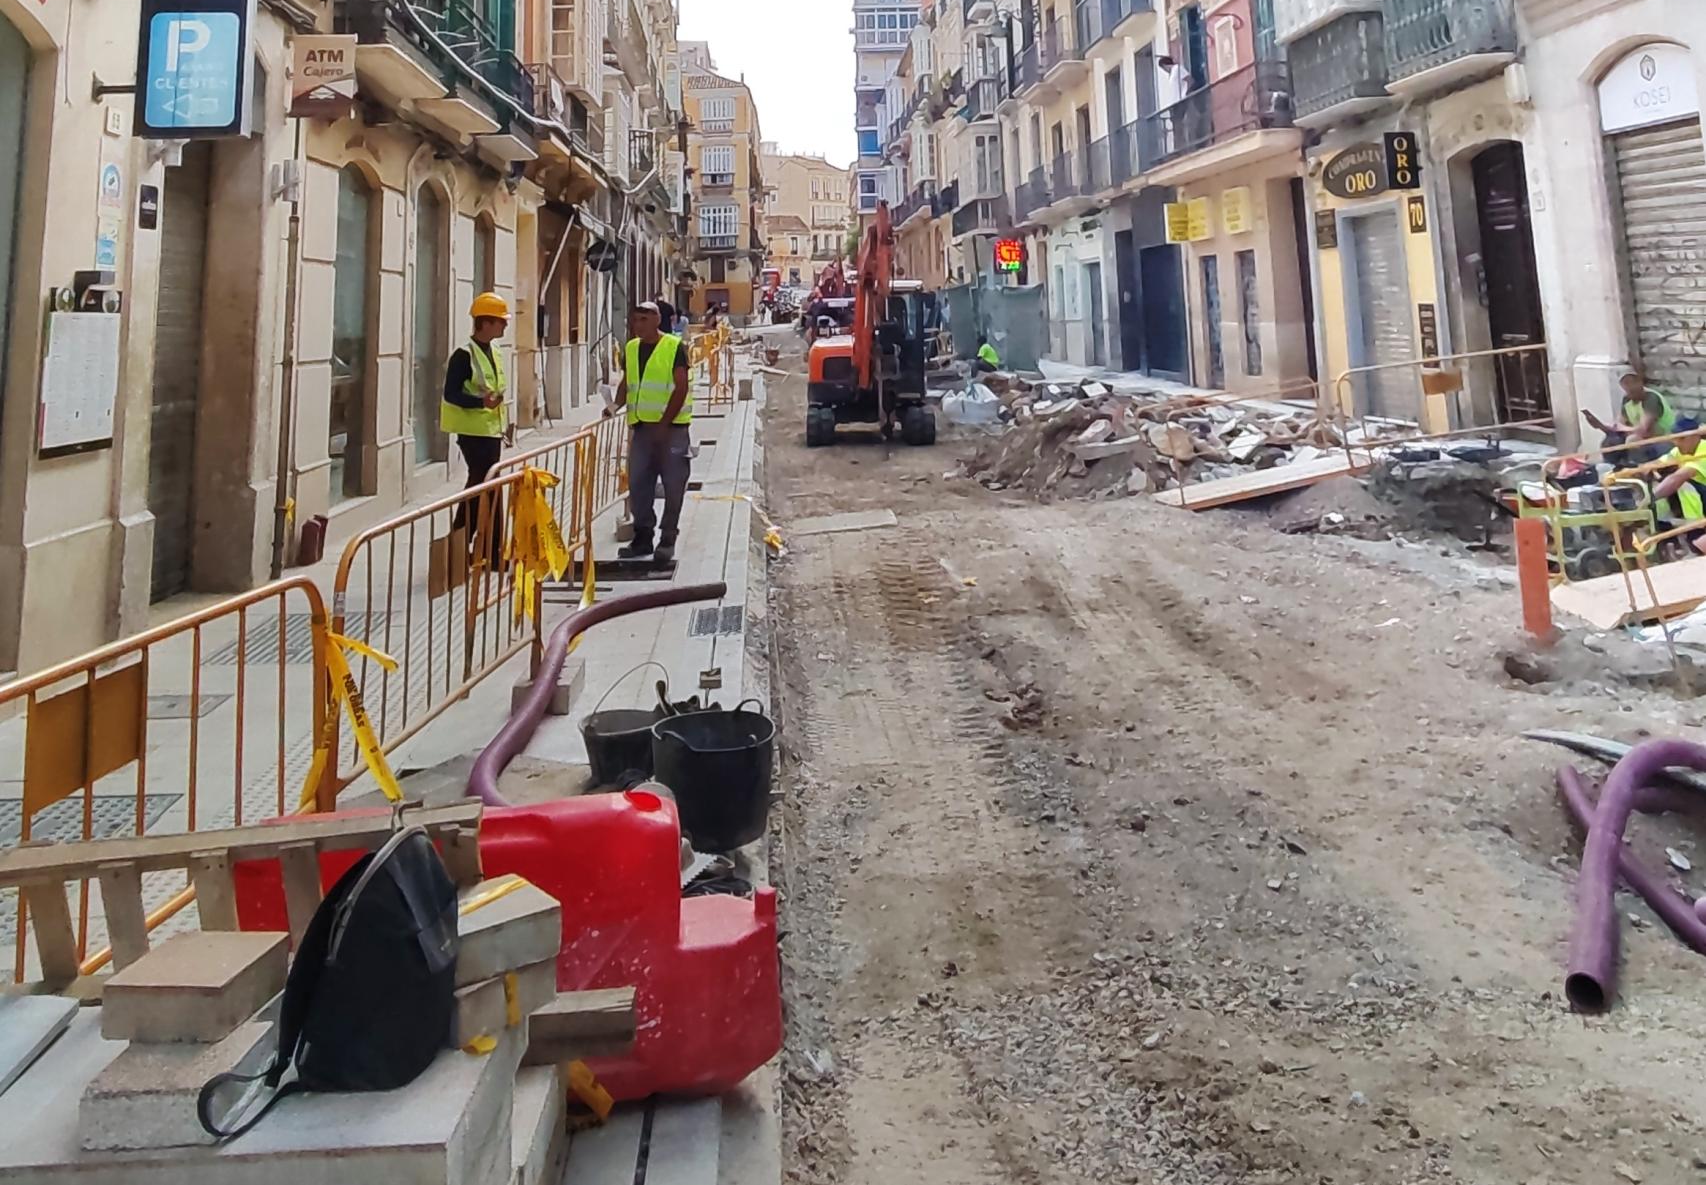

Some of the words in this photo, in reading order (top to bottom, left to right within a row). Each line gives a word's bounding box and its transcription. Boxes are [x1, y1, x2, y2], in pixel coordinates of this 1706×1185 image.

[166, 20, 211, 71] P
[305, 49, 343, 63] ATM
[303, 66, 343, 78] Cajero
[155, 77, 228, 89] CLENTES
[1393, 136, 1412, 184] ORO
[1345, 169, 1376, 193] ORO
